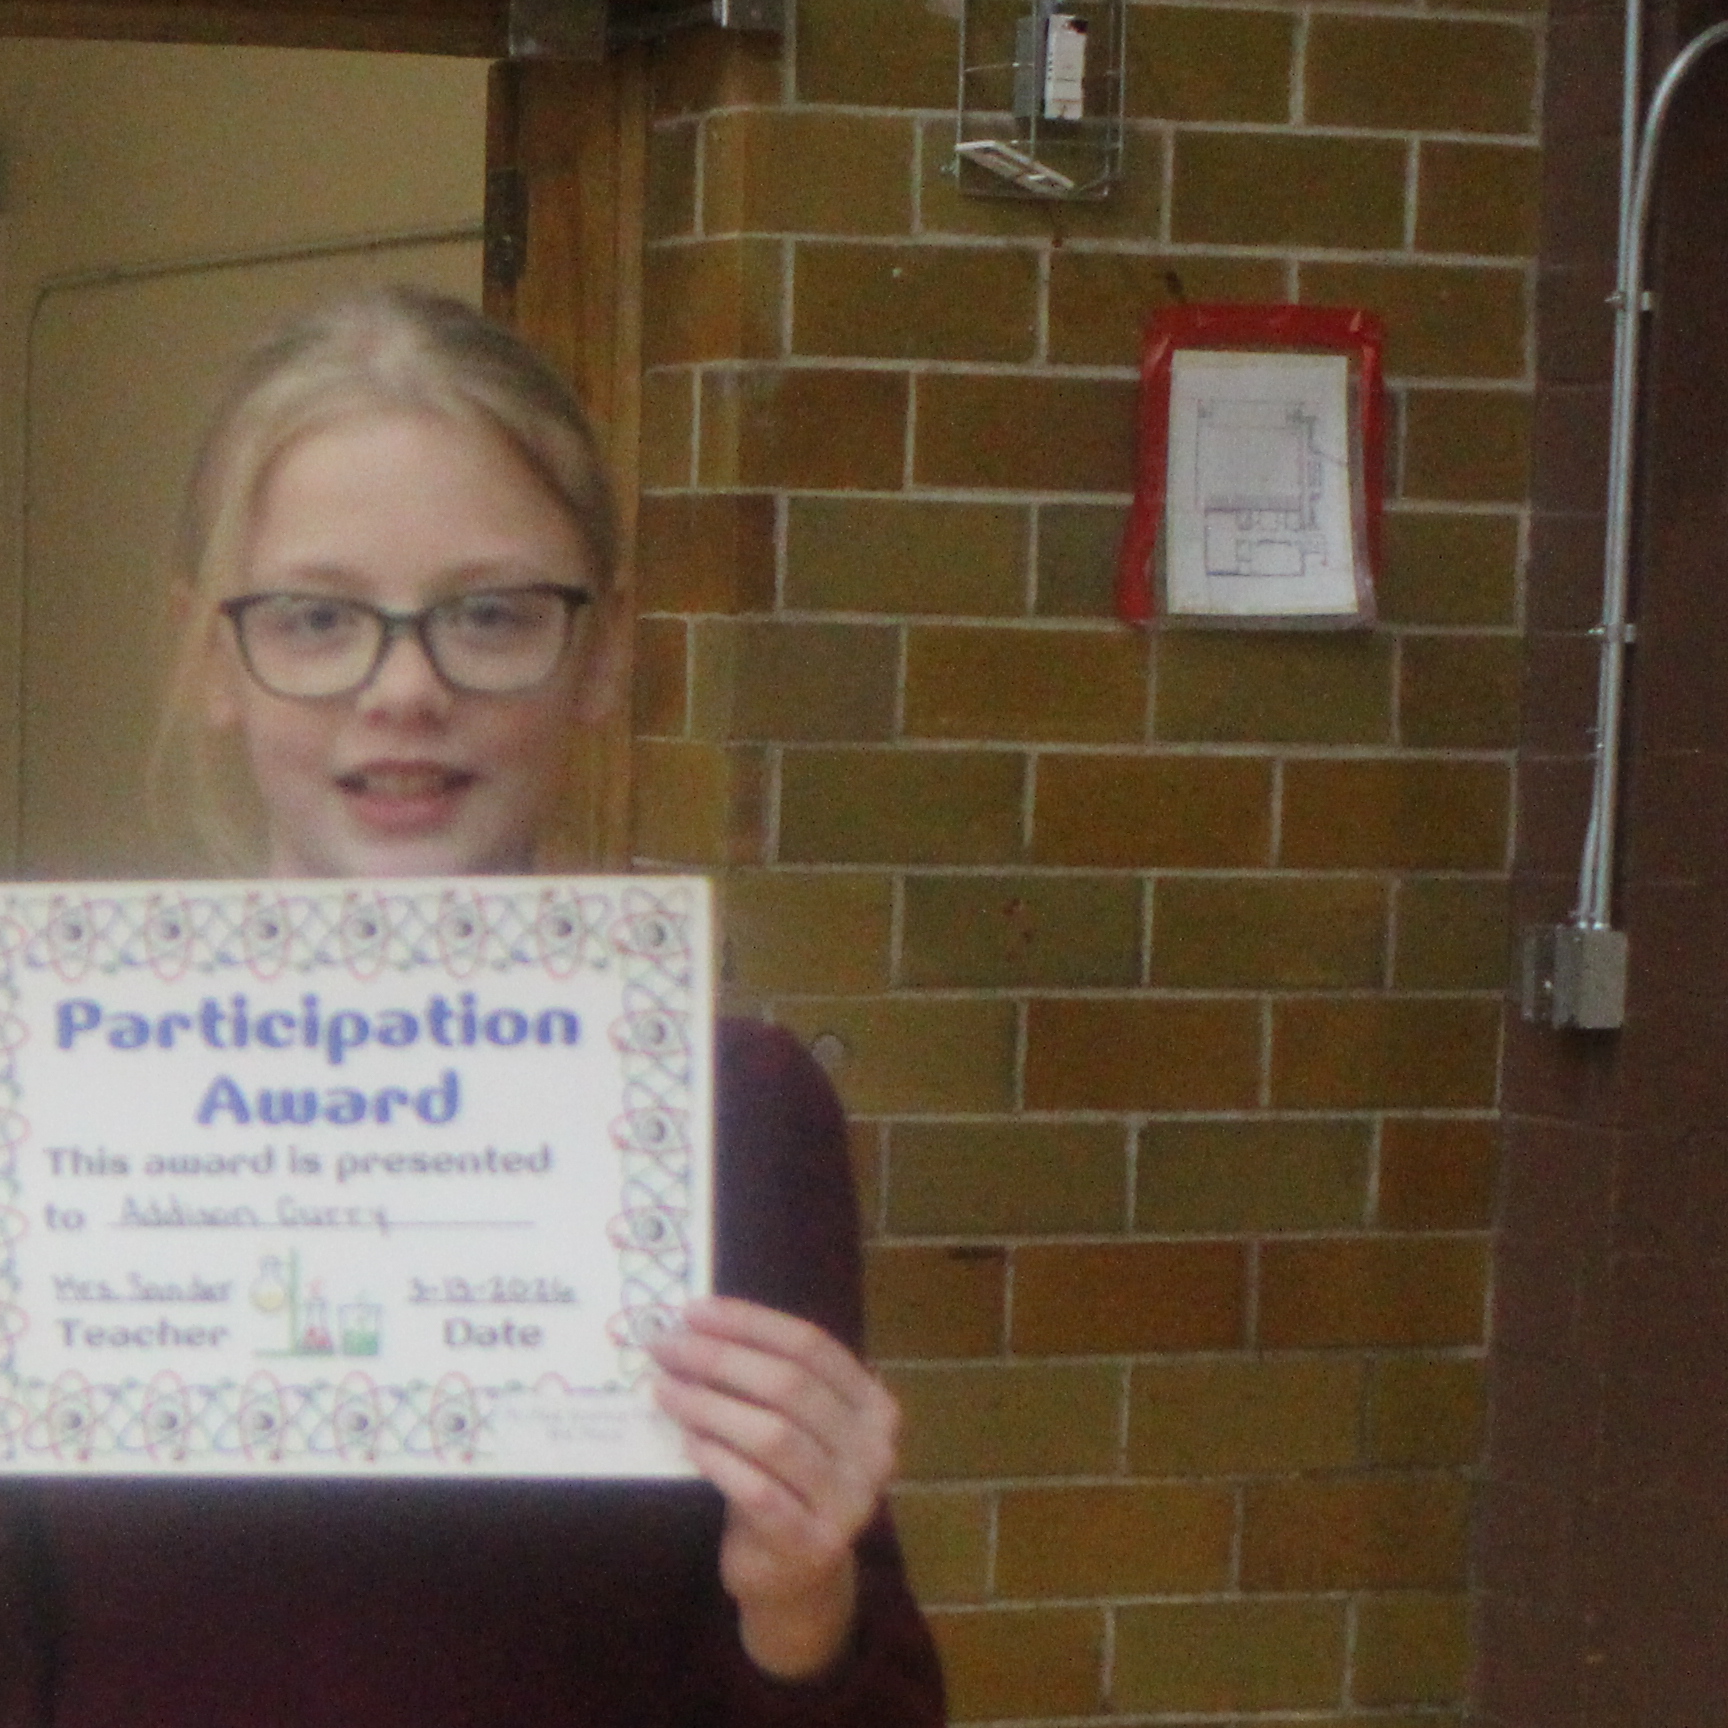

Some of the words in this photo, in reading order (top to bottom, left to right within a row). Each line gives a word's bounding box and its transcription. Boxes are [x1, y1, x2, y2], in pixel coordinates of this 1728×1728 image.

[55, 991, 581, 1065] Participation
[196, 1069, 461, 1125] Award
[44, 1146, 129, 1176] This
[144, 1146, 274, 1175] award
[288, 1145, 321, 1175] is
[336, 1144, 553, 1183] presented
[43, 1202, 86, 1231] to
[56, 1316, 229, 1347] Teacher
[443, 1318, 544, 1347] Date
